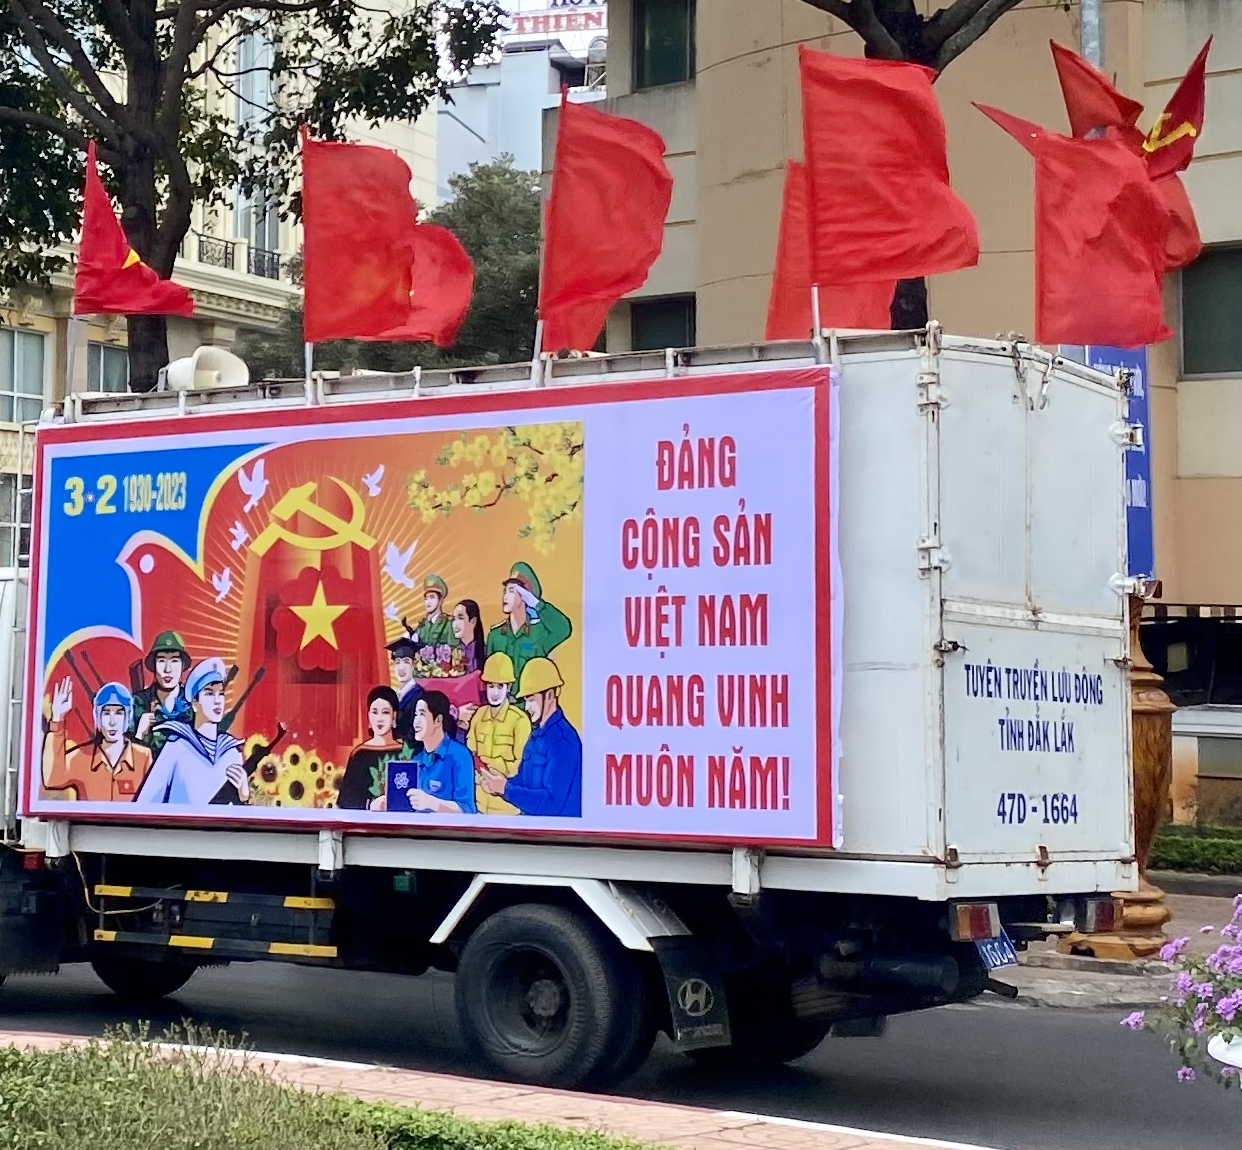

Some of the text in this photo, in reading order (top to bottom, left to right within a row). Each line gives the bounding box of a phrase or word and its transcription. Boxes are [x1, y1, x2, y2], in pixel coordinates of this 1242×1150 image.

[655, 423, 737, 490] ĐẢNG
[123, 471, 188, 513] 1930-2023
[621, 498, 772, 580] CỘNG SẢN
[625, 585, 768, 659] VIỆT NAM
[606, 674, 789, 730] QUANG VINH
[964, 658, 1003, 698] TUYÊN
[1074, 666, 1104, 712] ĐỘNG
[998, 707, 1024, 751] TỈNH
[605, 743, 790, 811] MUÔN NĂM!
